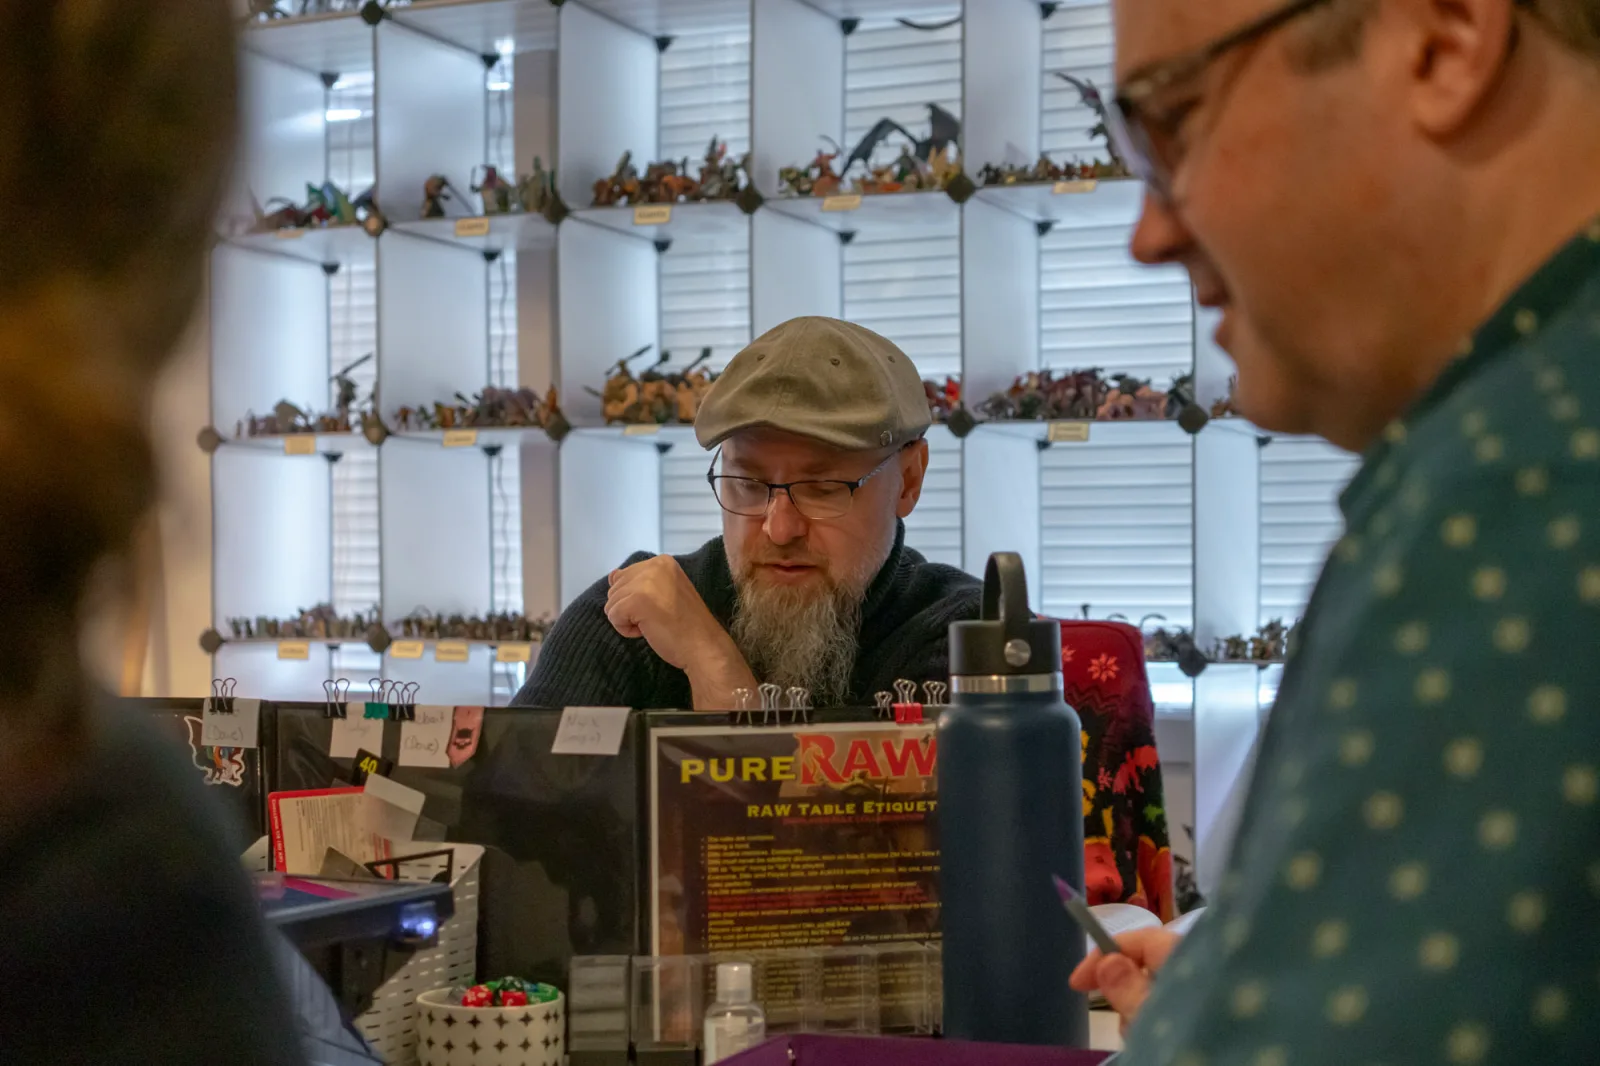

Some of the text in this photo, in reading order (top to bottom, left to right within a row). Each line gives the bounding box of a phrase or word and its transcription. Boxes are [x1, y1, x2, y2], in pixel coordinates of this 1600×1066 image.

[359, 755, 378, 775] 40
[680, 733, 937, 784] PURE RAW
[747, 801, 938, 817] RAW TABLE ETIQUET
